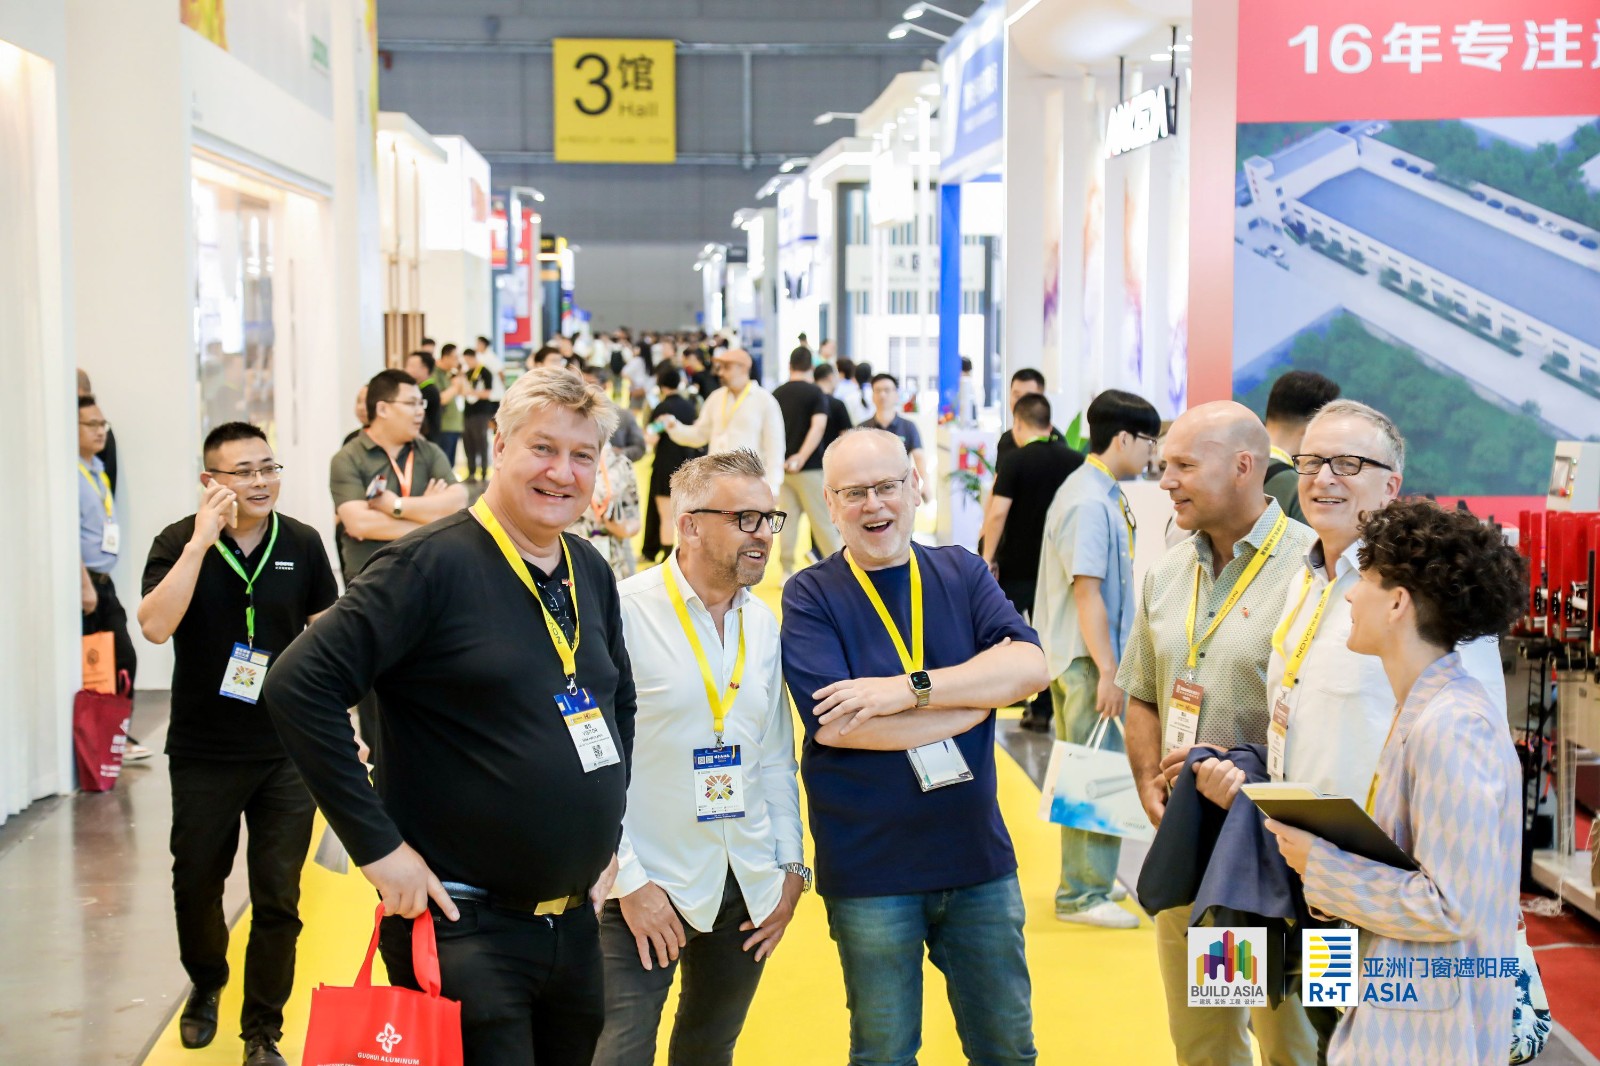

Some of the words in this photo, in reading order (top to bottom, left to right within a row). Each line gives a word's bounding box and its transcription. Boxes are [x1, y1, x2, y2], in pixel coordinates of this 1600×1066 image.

[1288, 18, 1600, 74] 16年专注
[619, 103, 659, 117] Hall
[357, 1052, 380, 1061] GUOHUI
[380, 1056, 420, 1065] ALUMINUM
